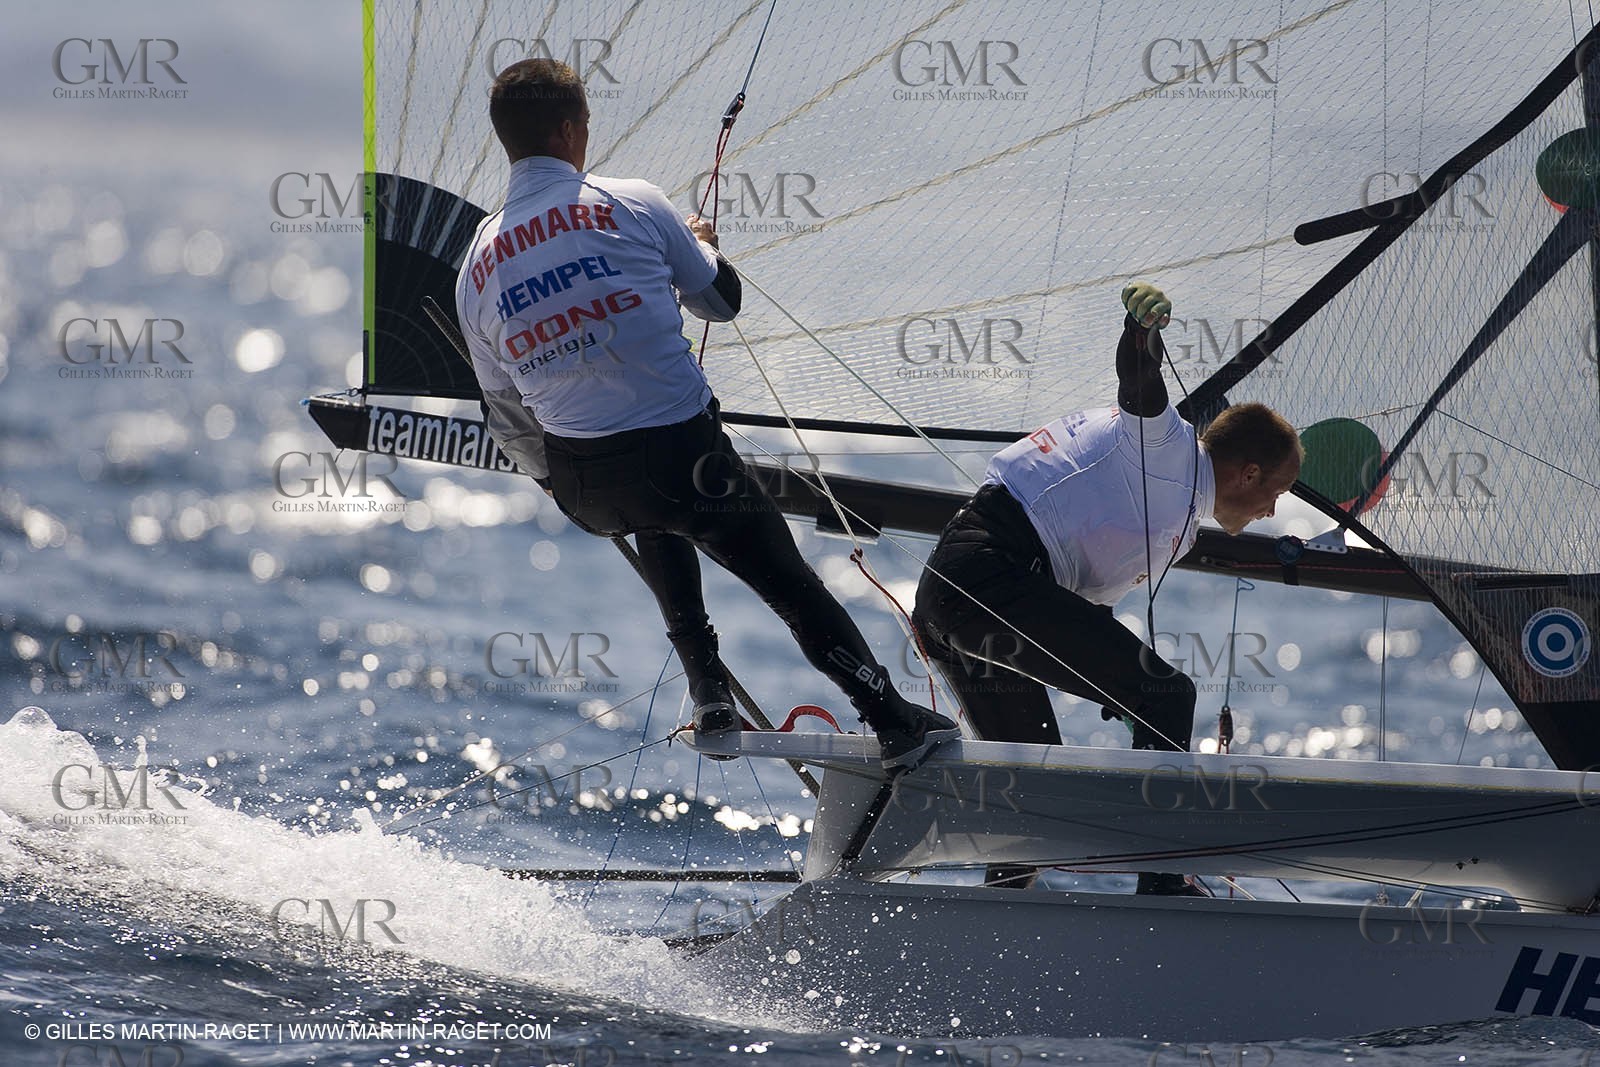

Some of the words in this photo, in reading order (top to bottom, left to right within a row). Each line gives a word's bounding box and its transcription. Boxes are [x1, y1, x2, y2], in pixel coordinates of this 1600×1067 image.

[471, 204, 620, 296] DENMARK
[496, 255, 622, 321] HEMPEL
[505, 288, 642, 360] DONG
[518, 332, 596, 375] energy
[367, 406, 527, 473] teamhan
